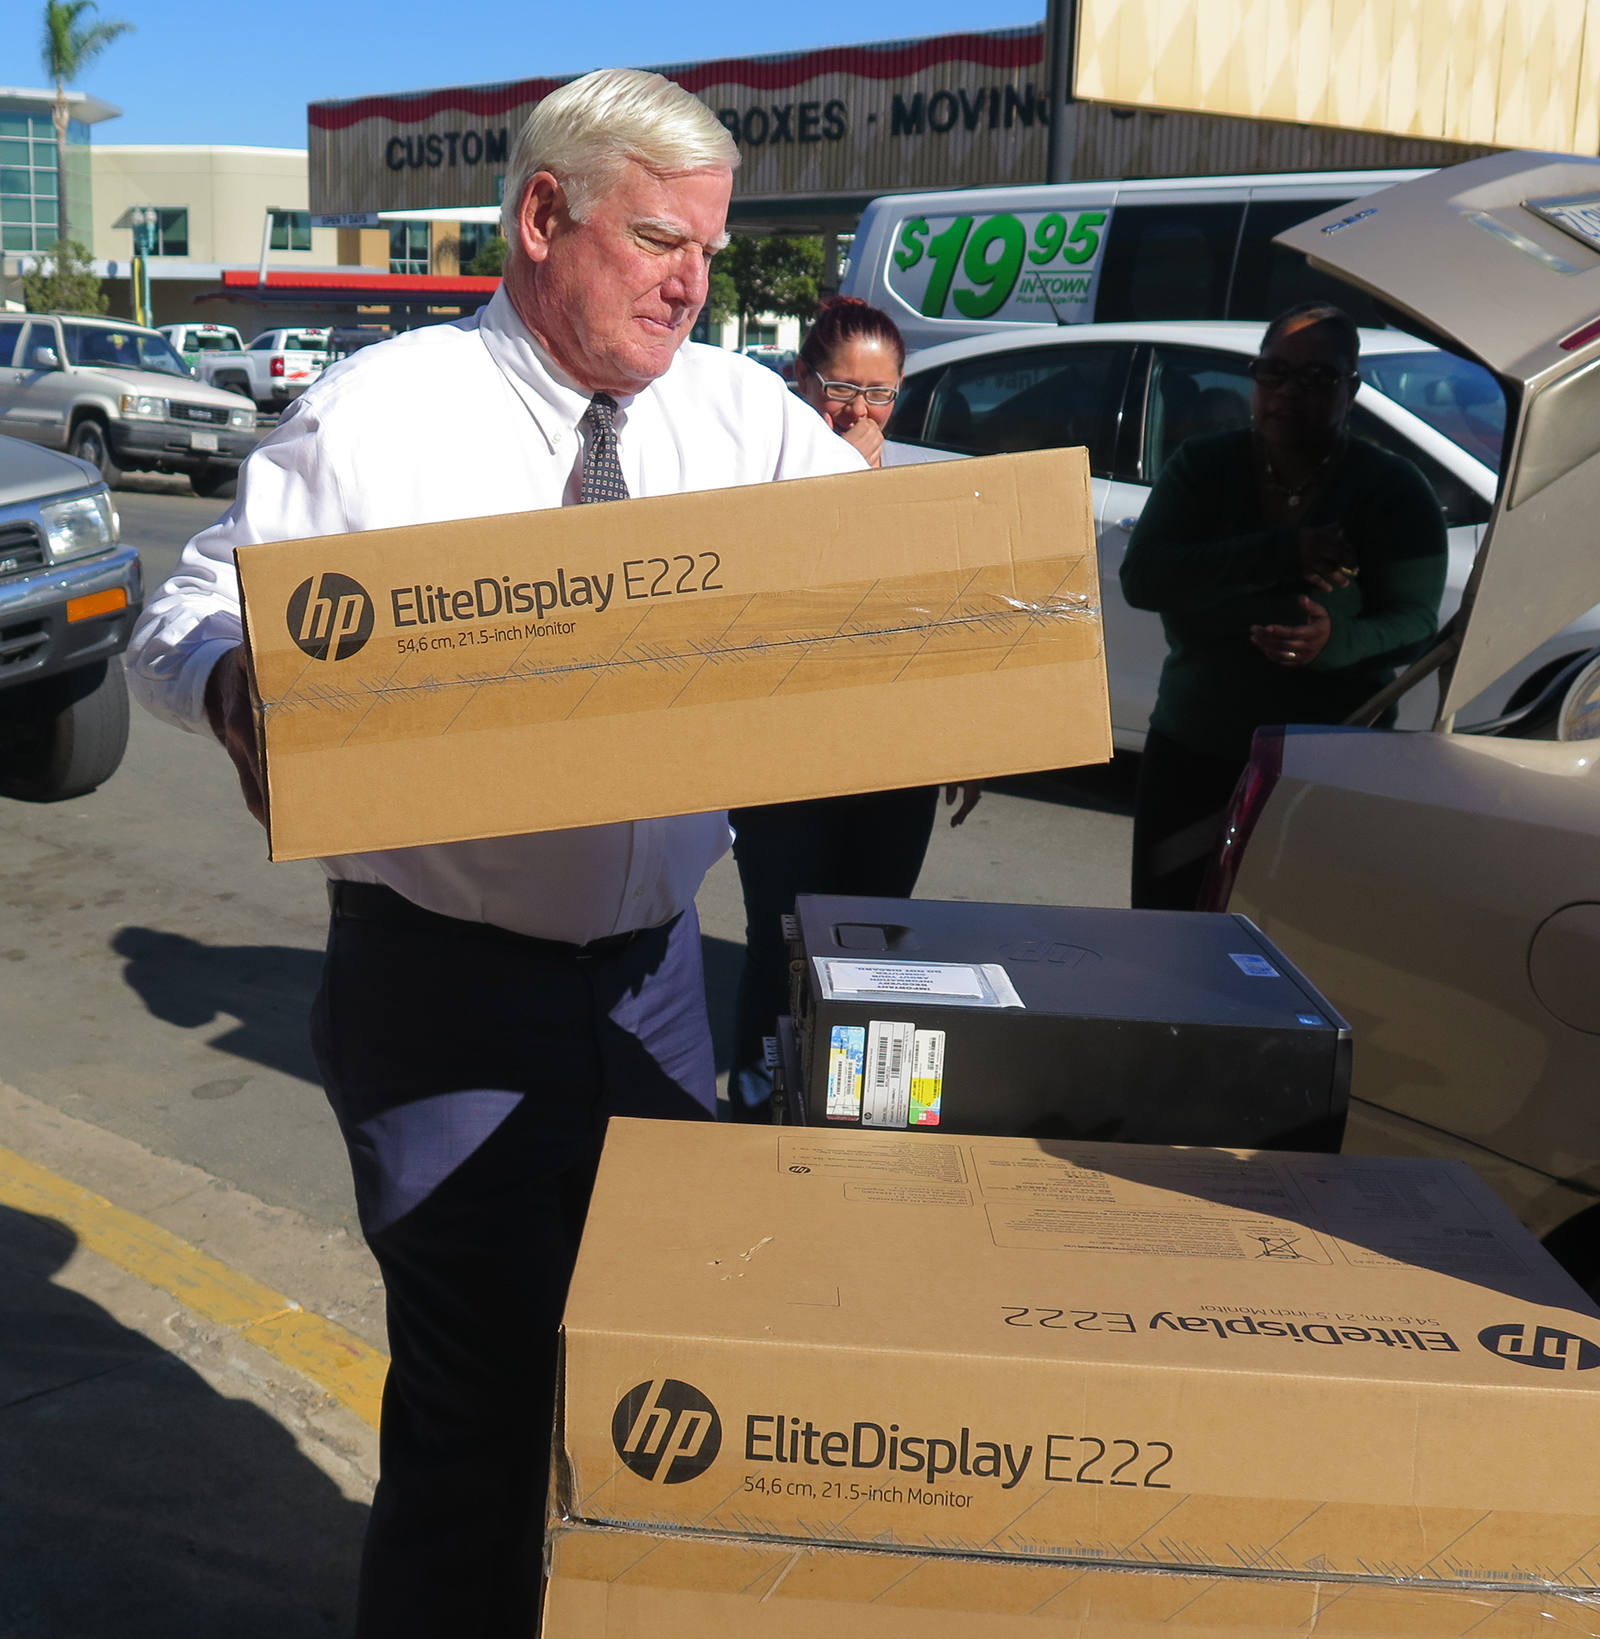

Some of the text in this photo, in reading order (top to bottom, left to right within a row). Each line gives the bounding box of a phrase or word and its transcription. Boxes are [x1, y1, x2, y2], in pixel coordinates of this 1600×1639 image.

[719, 99, 846, 146] BOXES
[386, 128, 508, 170] CUSTOM
[321, 216, 341, 225] OPEN
[349, 214, 367, 223] DAYS
[1019, 278, 1092, 293] IN-TOWN
[390, 551, 724, 627] EliteDisplay E222
[286, 572, 375, 662] hp
[397, 620, 577, 654] 54,6 cm, 21.5-inch Monitor
[1002, 1306, 1461, 1353] EliteDisplay E222
[1199, 1304, 1266, 1317] Monitor
[612, 1379, 722, 1484] hp
[745, 1414, 1174, 1489] EliteDisplay E222
[743, 1475, 974, 1508] 54,6 cm, 21.5-inch Monitor
